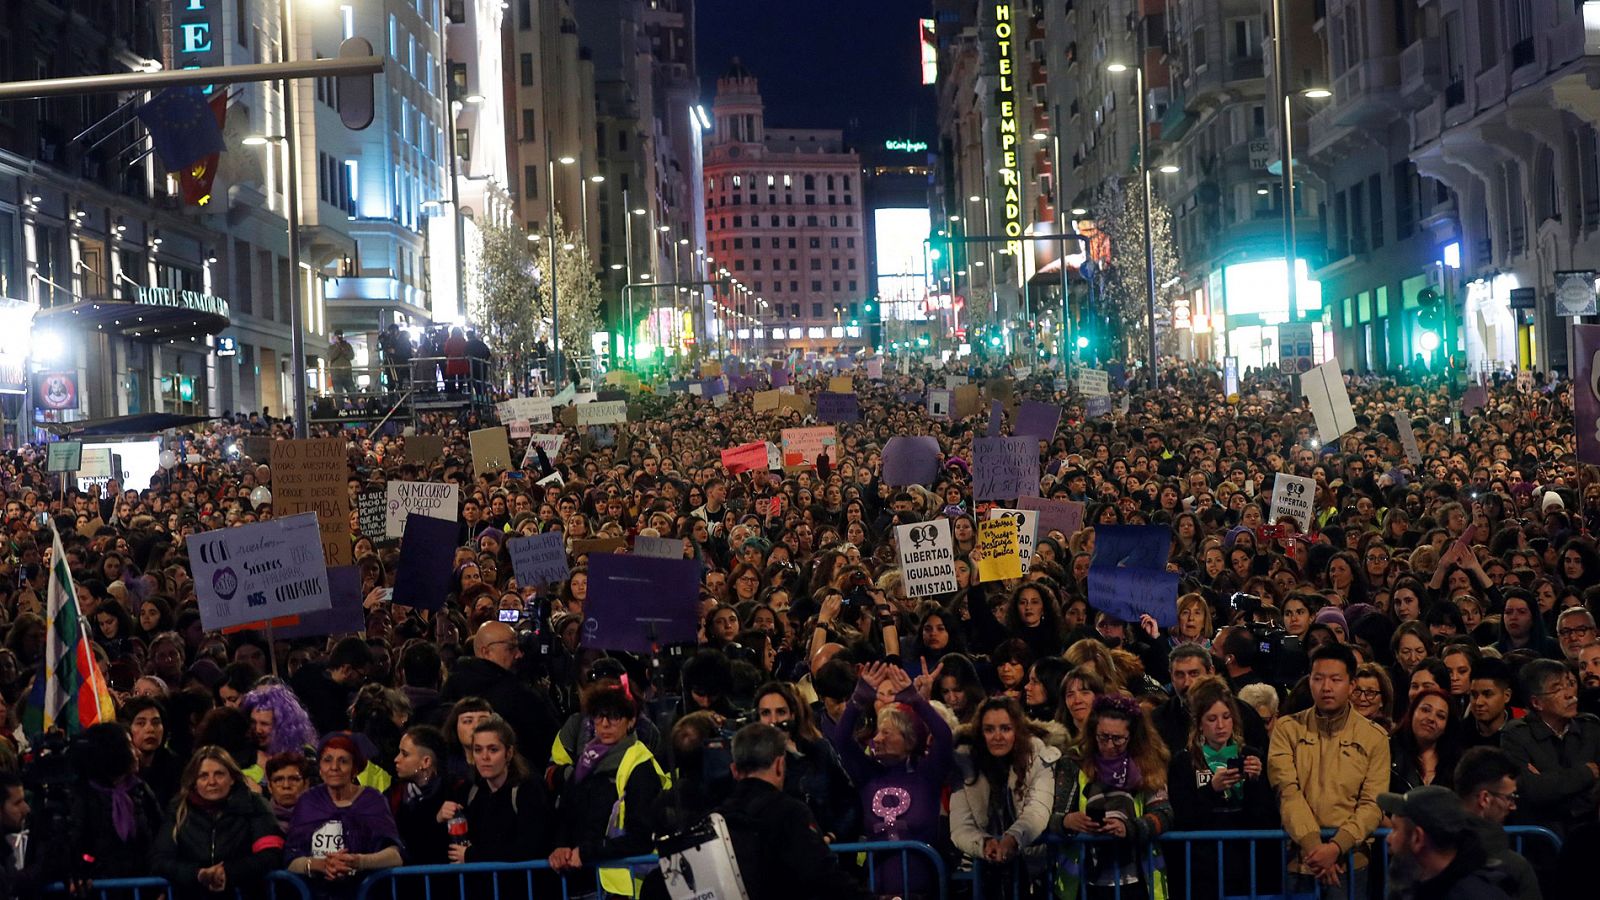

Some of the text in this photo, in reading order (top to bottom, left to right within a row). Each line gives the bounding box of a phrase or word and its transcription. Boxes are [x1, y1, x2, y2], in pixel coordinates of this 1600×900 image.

[996, 5, 1020, 256] HOTEL EMPERADOR
[139, 287, 179, 307] HOTEL
[273, 443, 297, 459] NO
[311, 487, 338, 497] DESDE
[358, 493, 367, 502] LO
[368, 491, 383, 500] QUE
[292, 500, 342, 518] TUMBA
[359, 499, 380, 508] MACHO
[1279, 496, 1309, 510] LIBERTAD,
[1276, 506, 1307, 520] IGUALDAD,
[200, 540, 232, 564] CON
[904, 547, 952, 564] LIBERTAD,
[907, 564, 954, 581] IGUALDAD,
[909, 581, 956, 597] AMISTAD.
